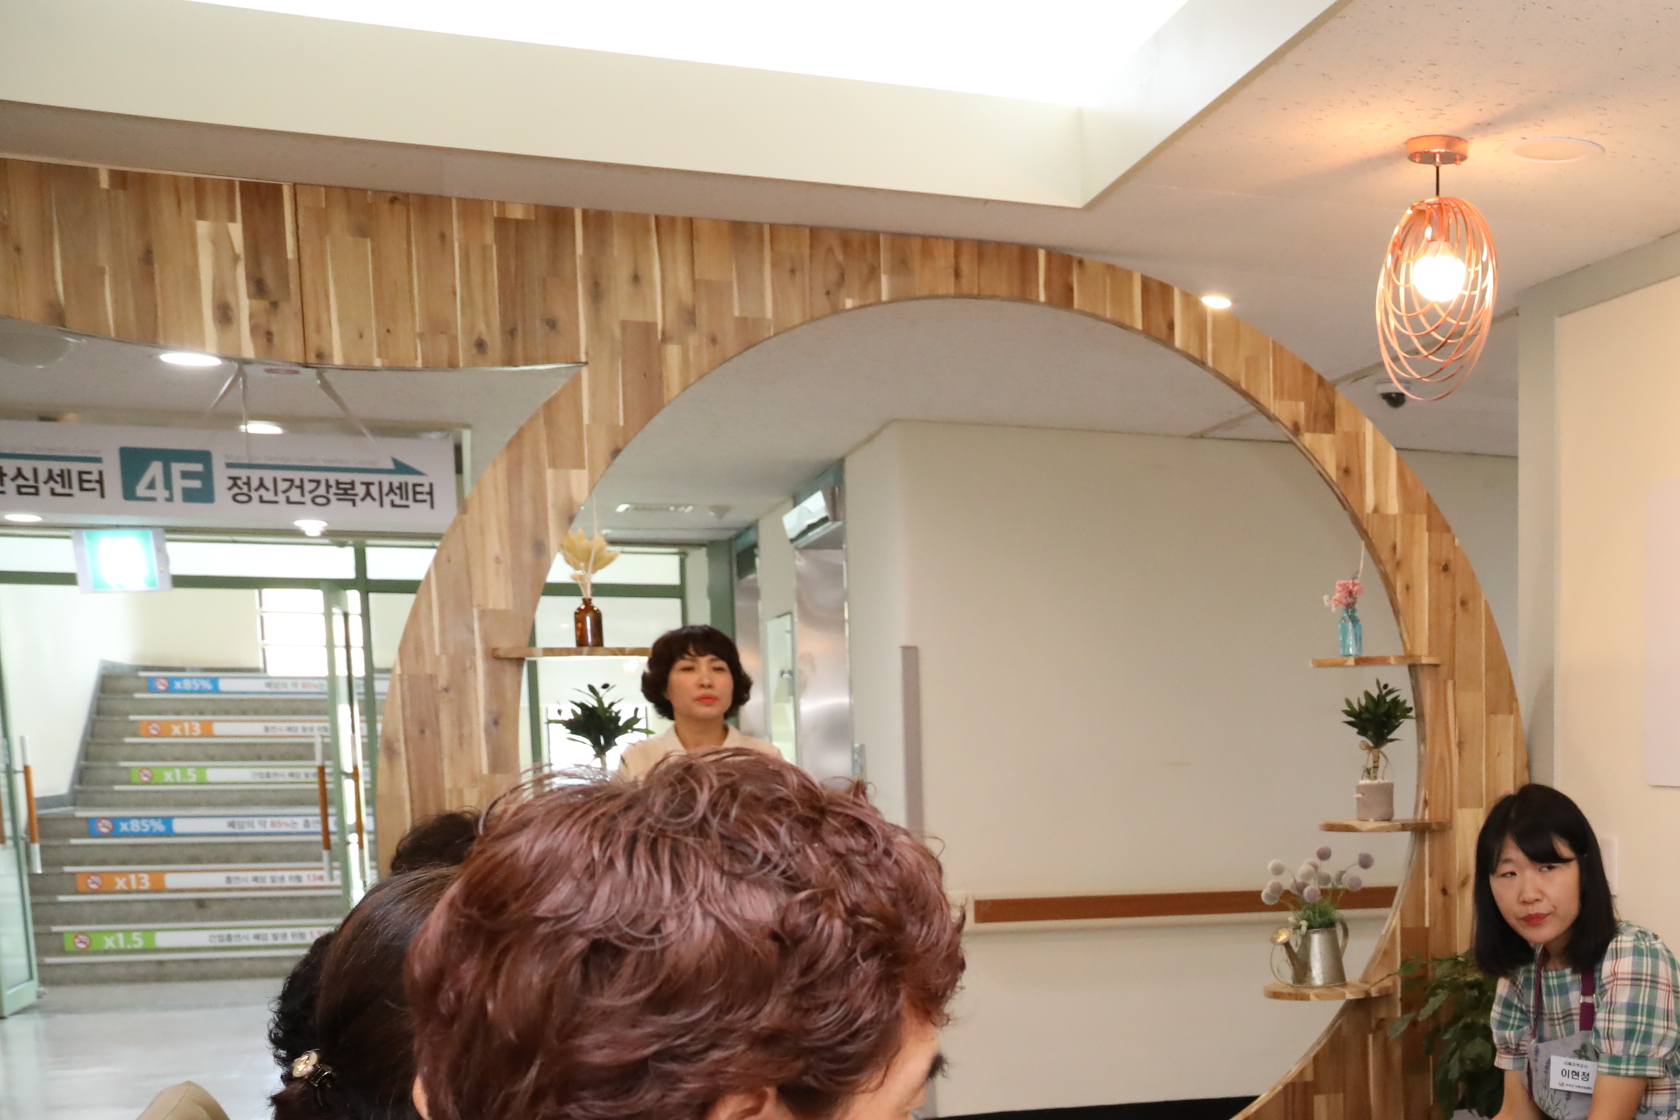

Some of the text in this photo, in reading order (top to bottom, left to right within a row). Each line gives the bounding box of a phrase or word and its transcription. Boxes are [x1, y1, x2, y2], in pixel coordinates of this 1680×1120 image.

[135, 460, 204, 502] 4F
[226, 475, 435, 509] 정신건강복지센터
[114, 873, 150, 890] x13
[103, 932, 144, 949] x1.5
[1560, 1068, 1590, 1082] 이현정
